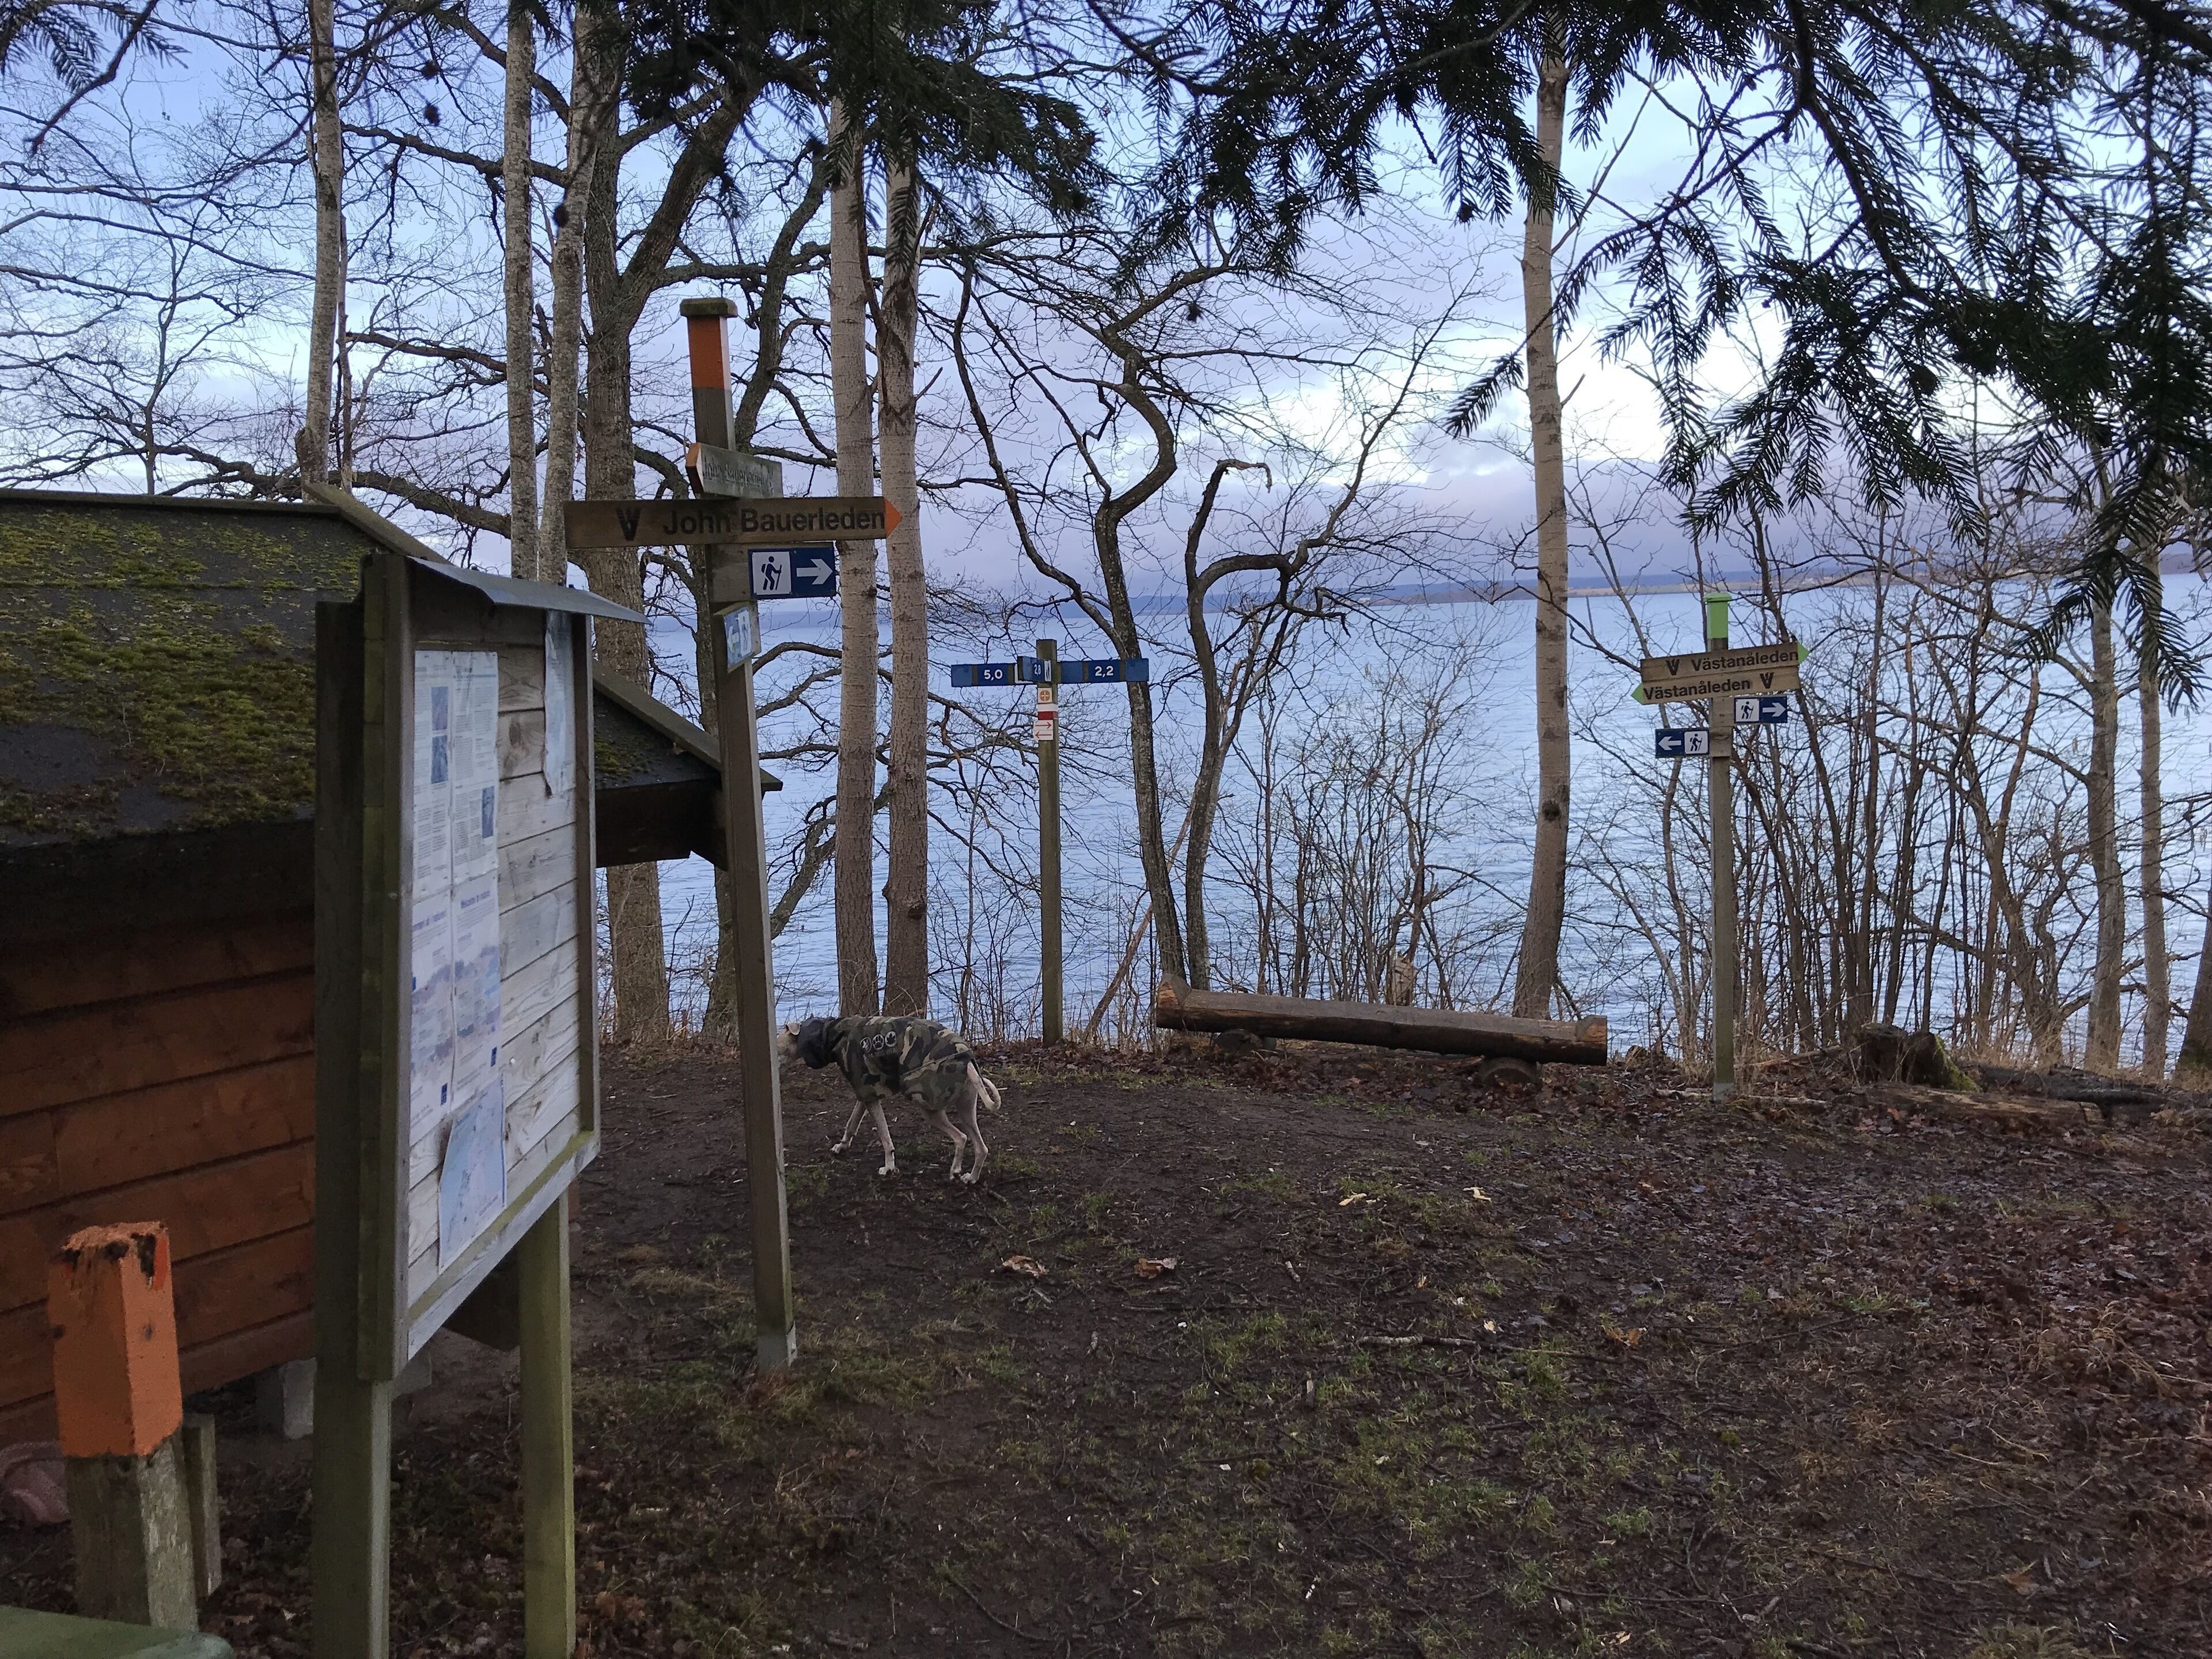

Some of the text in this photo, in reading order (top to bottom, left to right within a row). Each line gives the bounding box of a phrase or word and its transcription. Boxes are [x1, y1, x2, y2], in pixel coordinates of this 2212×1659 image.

[663, 509, 731, 535] John
[740, 507, 885, 532] Bauerleden
[1691, 651, 1798, 671] Västanåleden
[984, 669, 1003, 681] 5,0
[1094, 665, 1114, 678] 2,2
[1643, 679, 1751, 700] Västanåleden
